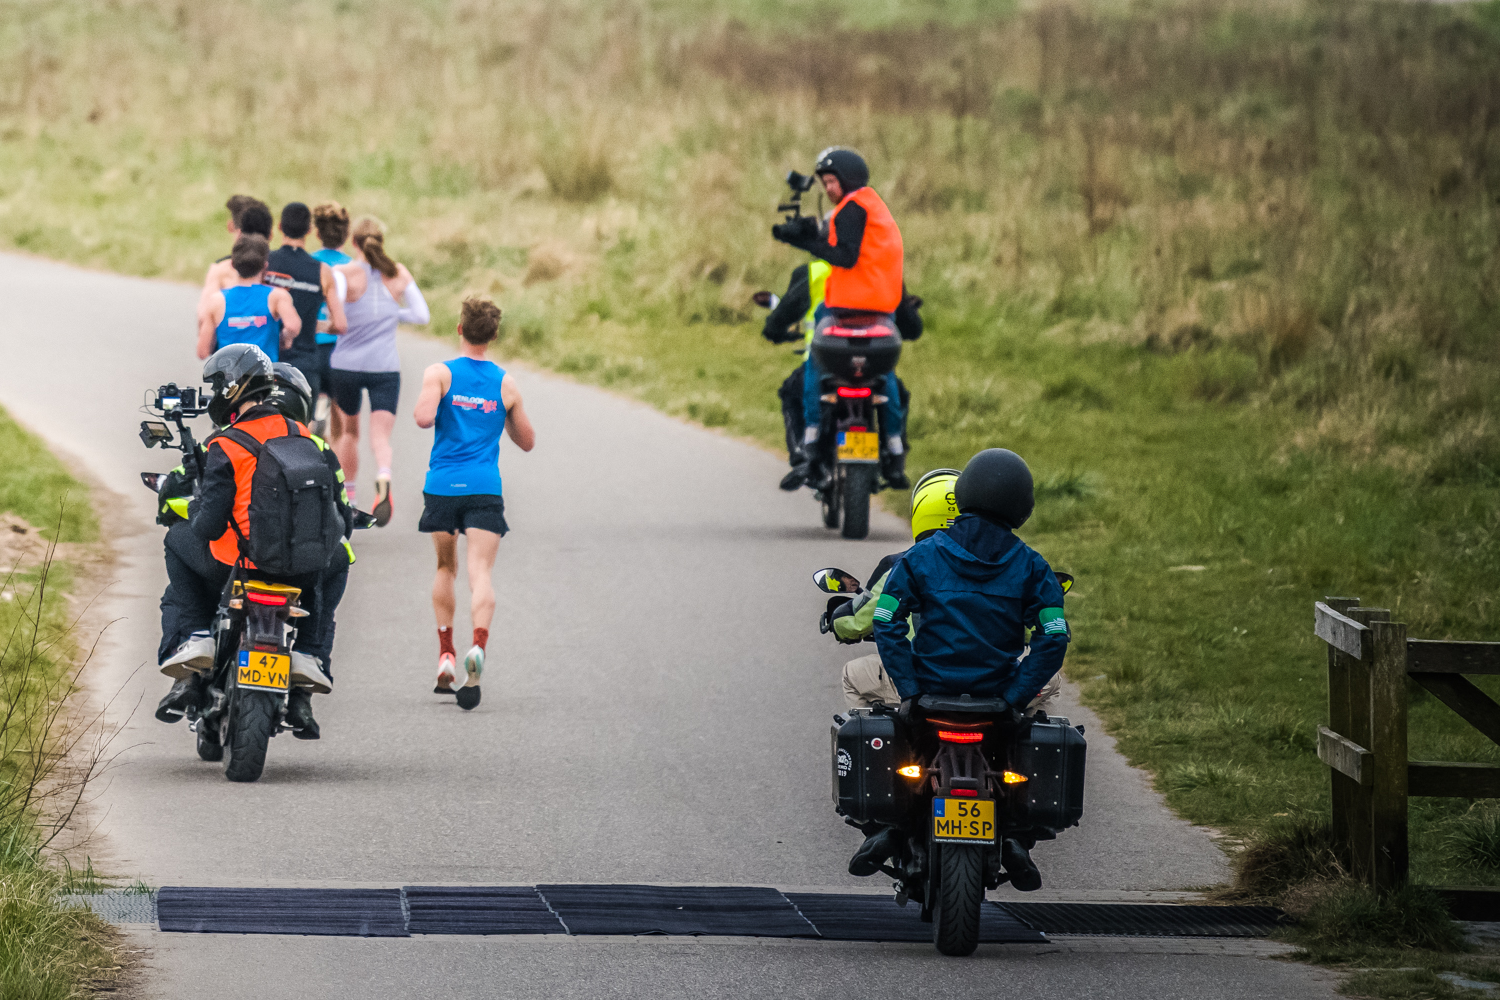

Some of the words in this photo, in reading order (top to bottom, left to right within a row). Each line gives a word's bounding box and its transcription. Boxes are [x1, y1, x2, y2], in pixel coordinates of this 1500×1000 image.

[259, 655, 278, 668] 47
[239, 669, 288, 686] MD-VN
[958, 801, 981, 818] 56
[936, 819, 993, 837] MH-SP
